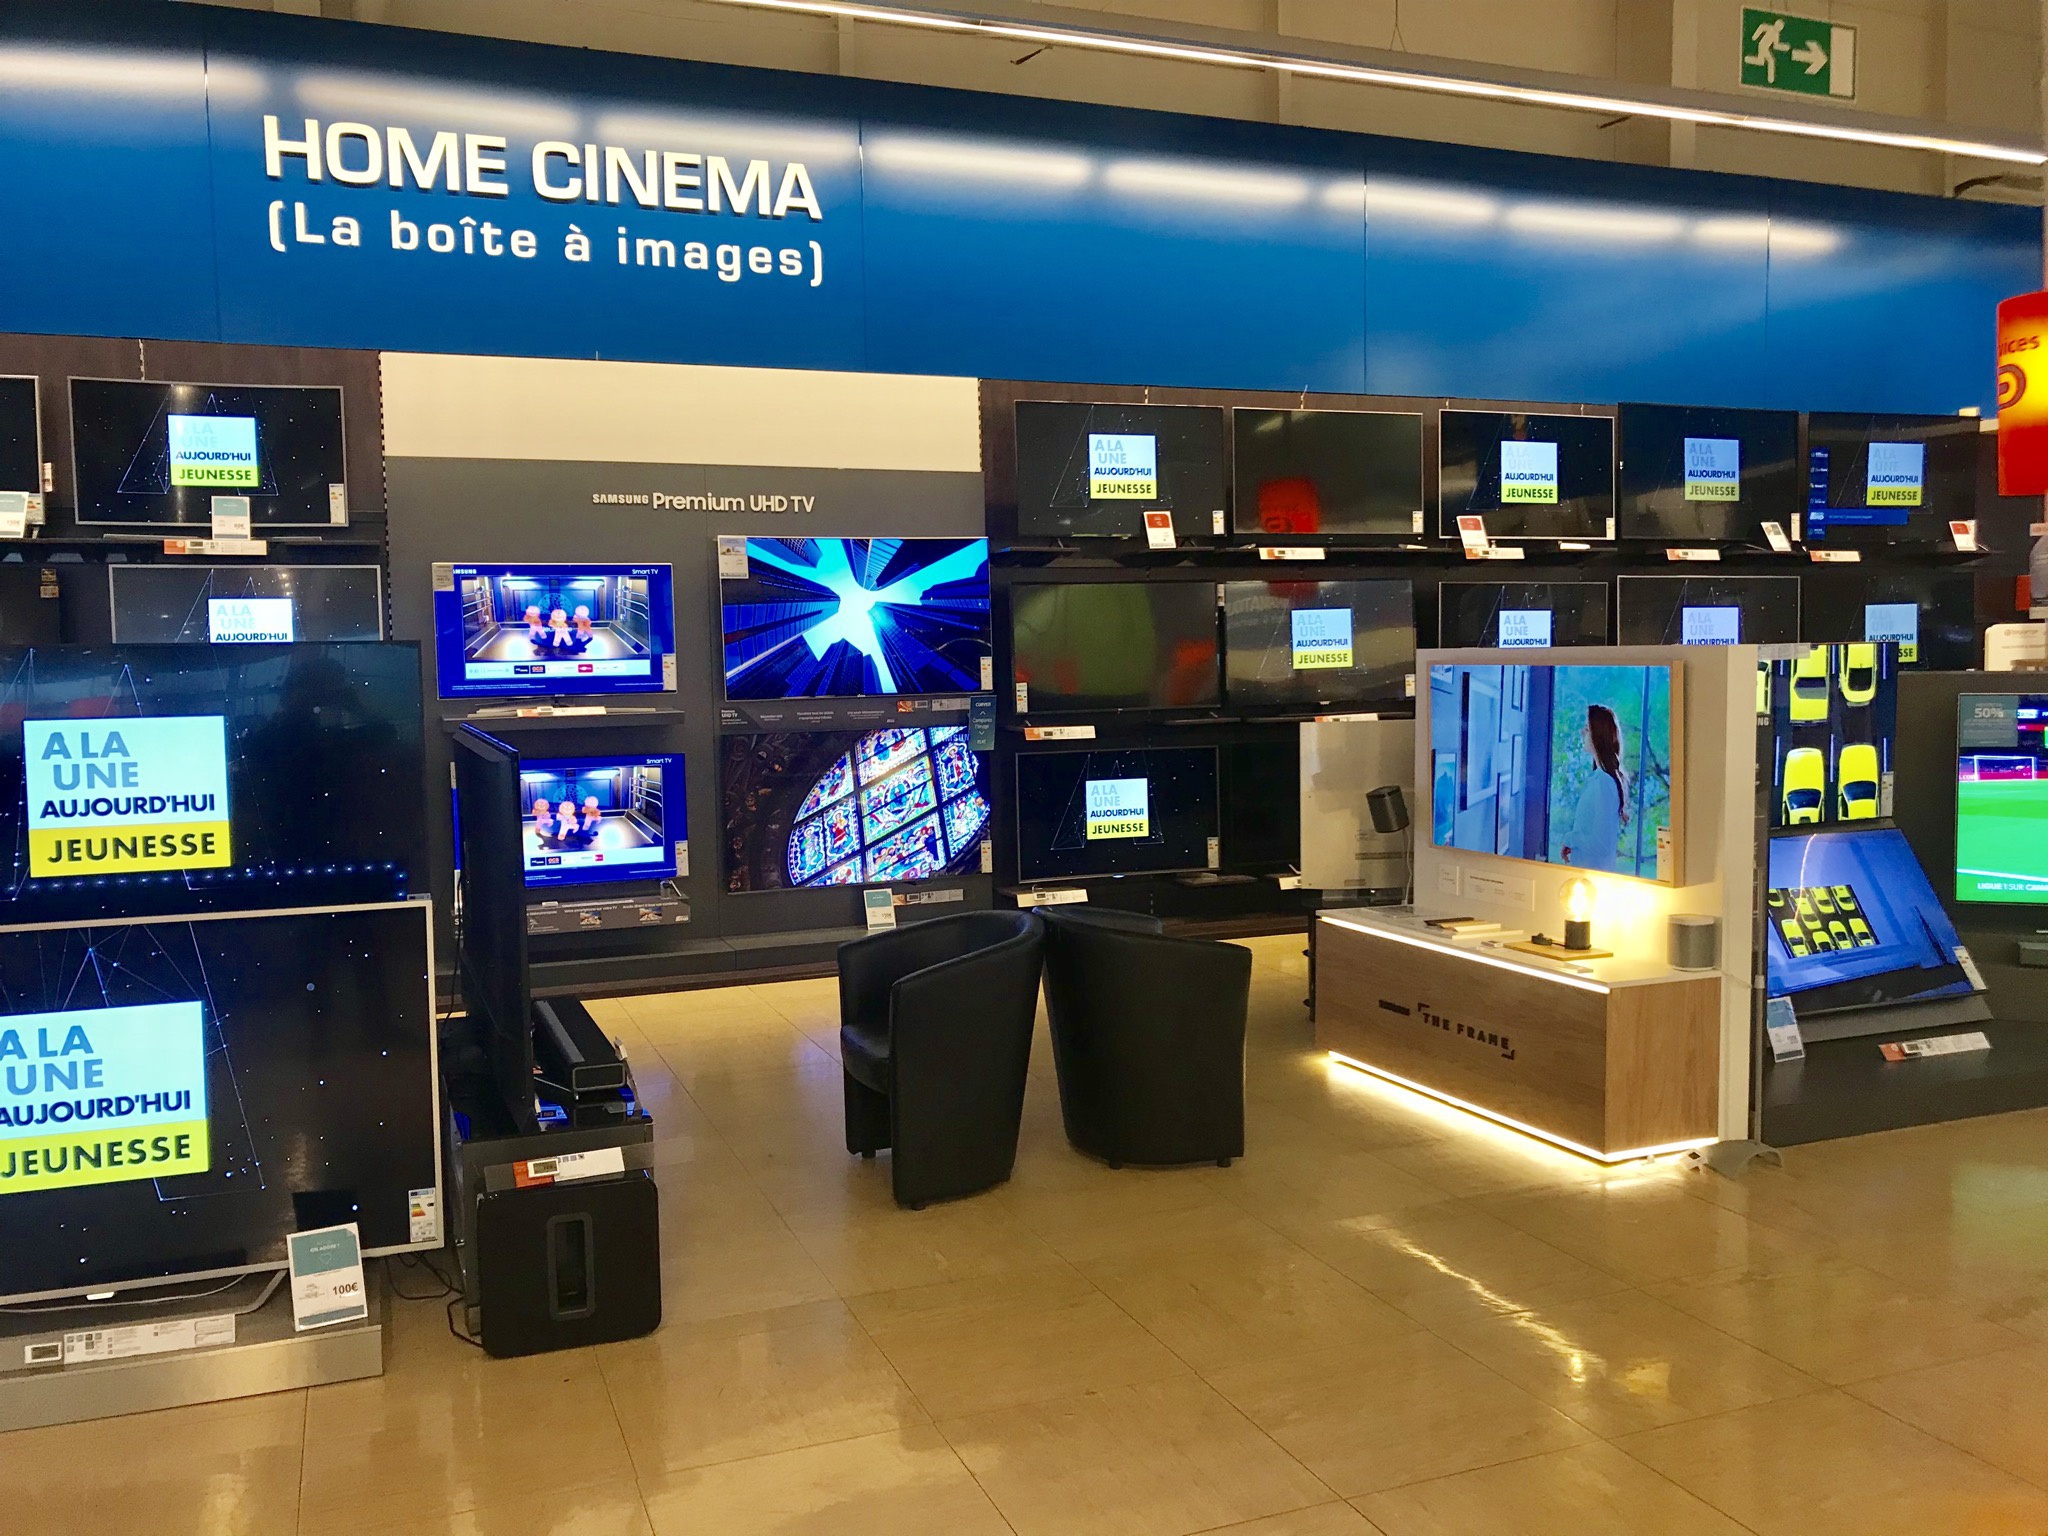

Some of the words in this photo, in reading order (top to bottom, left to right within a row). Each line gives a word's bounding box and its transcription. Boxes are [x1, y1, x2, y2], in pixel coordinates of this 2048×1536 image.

[264, 115, 508, 195] HOME
[532, 141, 823, 220] CINEMA
[269, 200, 360, 253] (La
[390, 210, 537, 258] boîte
[564, 224, 591, 262] à
[618, 226, 823, 287] images)
[1107, 440, 1124, 452] LA
[1699, 443, 1713, 455] LA
[176, 451, 251, 461] AUJOURD'HUI
[1098, 452, 1127, 465] UNE
[1691, 456, 1715, 467] UNE
[179, 469, 251, 481] JEUNESSE
[1094, 467, 1152, 476] AUJOURD'HUI
[1505, 472, 1554, 482] AUJOURD'HUI
[1688, 469, 1736, 479] AUJOURD'HUI
[1871, 474, 1919, 483] AUJOURD'HUI
[1096, 484, 1152, 494] JEUNESSE
[1506, 488, 1554, 499] JEUNESSE
[1689, 485, 1736, 496] JEUNESSE
[1871, 491, 1918, 501] JEUNESSE
[592, 493, 649, 505] SAMSUNG
[652, 492, 745, 512] Premium
[750, 494, 788, 512] UHD
[790, 496, 815, 513] TV
[232, 604, 252, 616] LA
[221, 617, 255, 630] UNE
[1308, 614, 1323, 626] LA
[1513, 615, 1526, 626] LA
[1698, 612, 1711, 624] LA
[215, 632, 288, 641] AUJOURD'HUI
[1300, 626, 1326, 637] UNE
[1505, 626, 1529, 637] UNE
[1690, 625, 1714, 636] UNE
[1297, 638, 1348, 648] AUJOURD'HUI
[1503, 639, 1548, 647] AUJOURD'HUI
[1299, 653, 1349, 665] JEUNESSE
[1974, 707, 2004, 718] 50%
[41, 732, 72, 760] A
[81, 731, 131, 759] LA
[53, 762, 139, 791] UNE
[1102, 784, 1118, 796] LA
[39, 793, 215, 819] AUJOURD'HUI
[1094, 796, 1120, 808] UNE
[1090, 808, 1144, 818] AUJOURD'HUI
[1092, 823, 1144, 835] JEUNESSE
[47, 832, 216, 863] JEUNESSE
[1422, 1012, 1450, 1031] THE
[1457, 1023, 1509, 1050] FRAME
[0, 1029, 28, 1060] A
[38, 1025, 94, 1058] LA
[7, 1058, 104, 1096] UNE
[0, 1090, 191, 1128] AUJOURD'HUI
[0, 1133, 191, 1178] JEUNESSE
[332, 1282, 359, 1295] 100€
